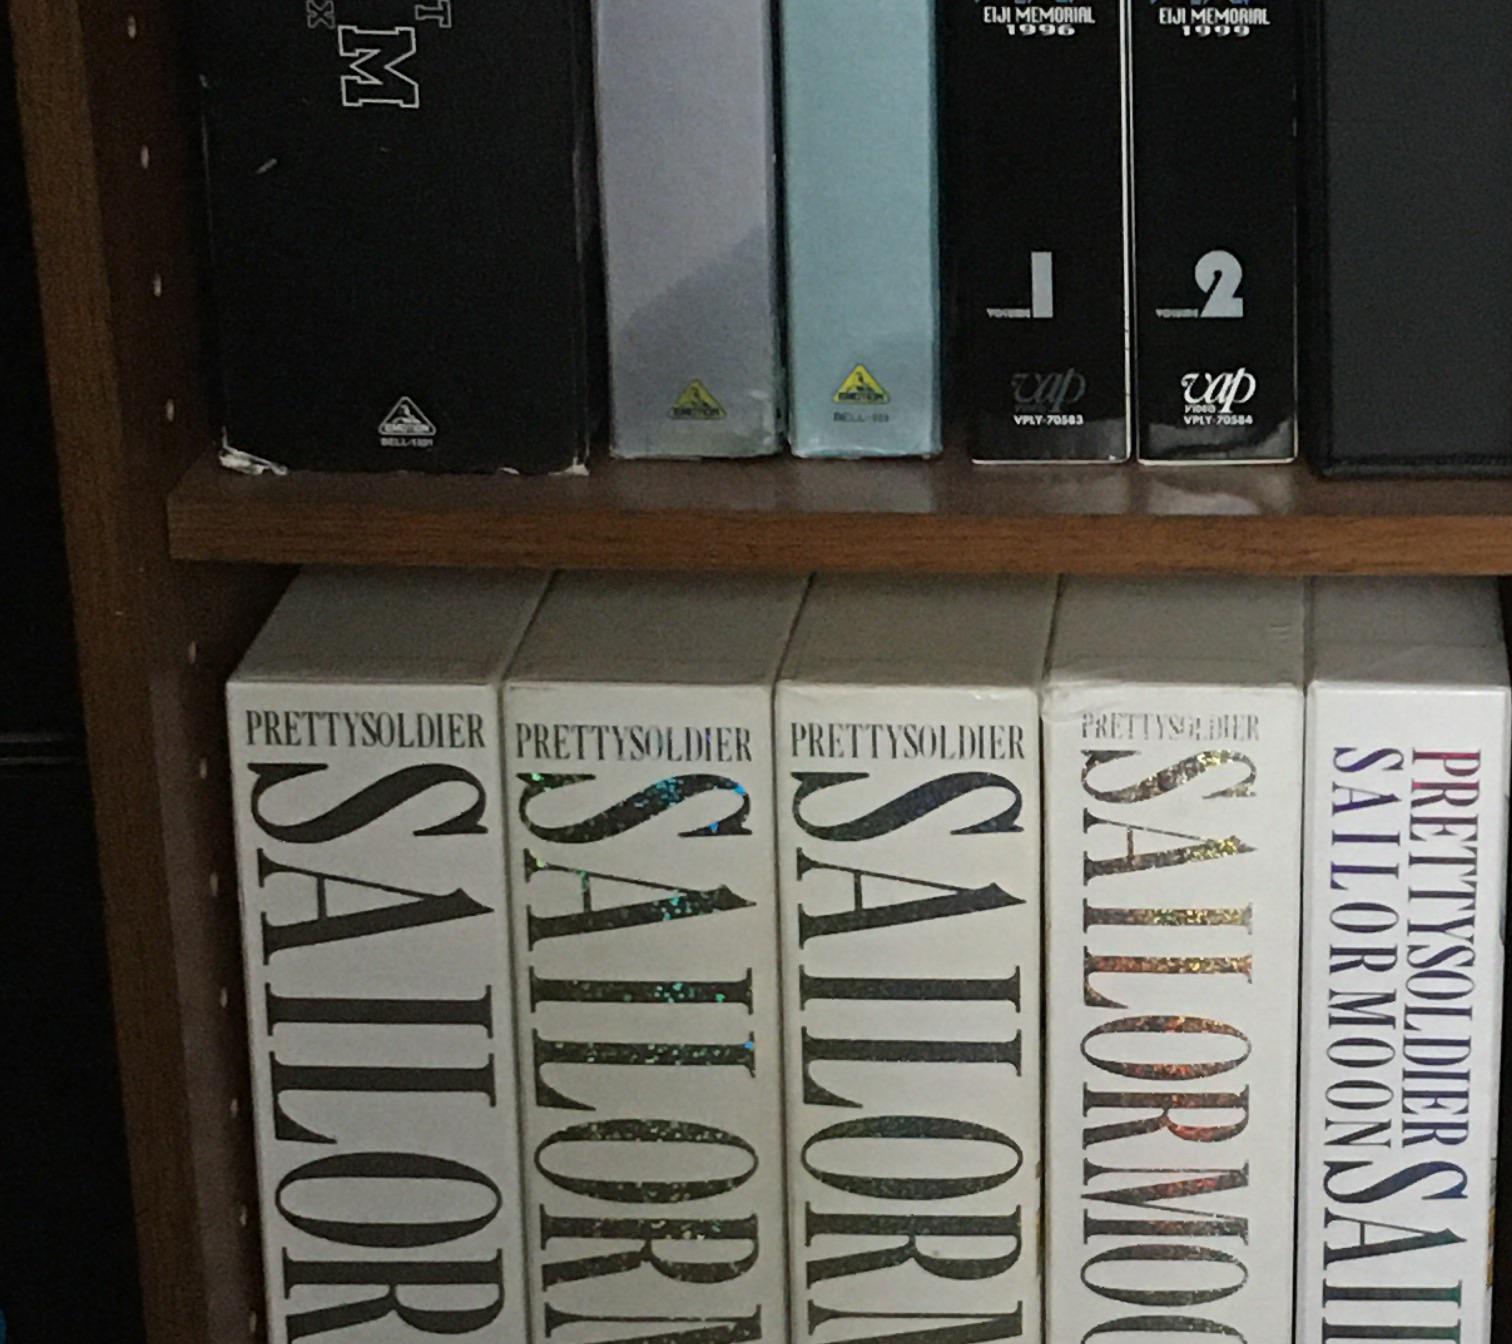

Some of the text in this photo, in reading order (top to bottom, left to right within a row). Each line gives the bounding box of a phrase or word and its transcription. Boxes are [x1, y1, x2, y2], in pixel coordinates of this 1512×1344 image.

[984, 6, 1095, 24] EIJI MEMORIAL
[1006, 23, 1076, 36] 1996
[1159, 7, 1270, 25] EIJI MEMORIAL
[1182, 24, 1250, 37] 1999
[1194, 250, 1244, 318] 2
[1011, 367, 1087, 413] vap
[1180, 367, 1256, 413] vap
[246, 709, 487, 749] PRETTYSOLDIER
[515, 723, 753, 763] PRETTYSOLDIER
[790, 721, 1026, 762] PRETTYSOLDIER
[1081, 711, 1261, 743] PRETTYSOLDIER
[1400, 747, 1483, 1149] PRETTYSOLDIER
